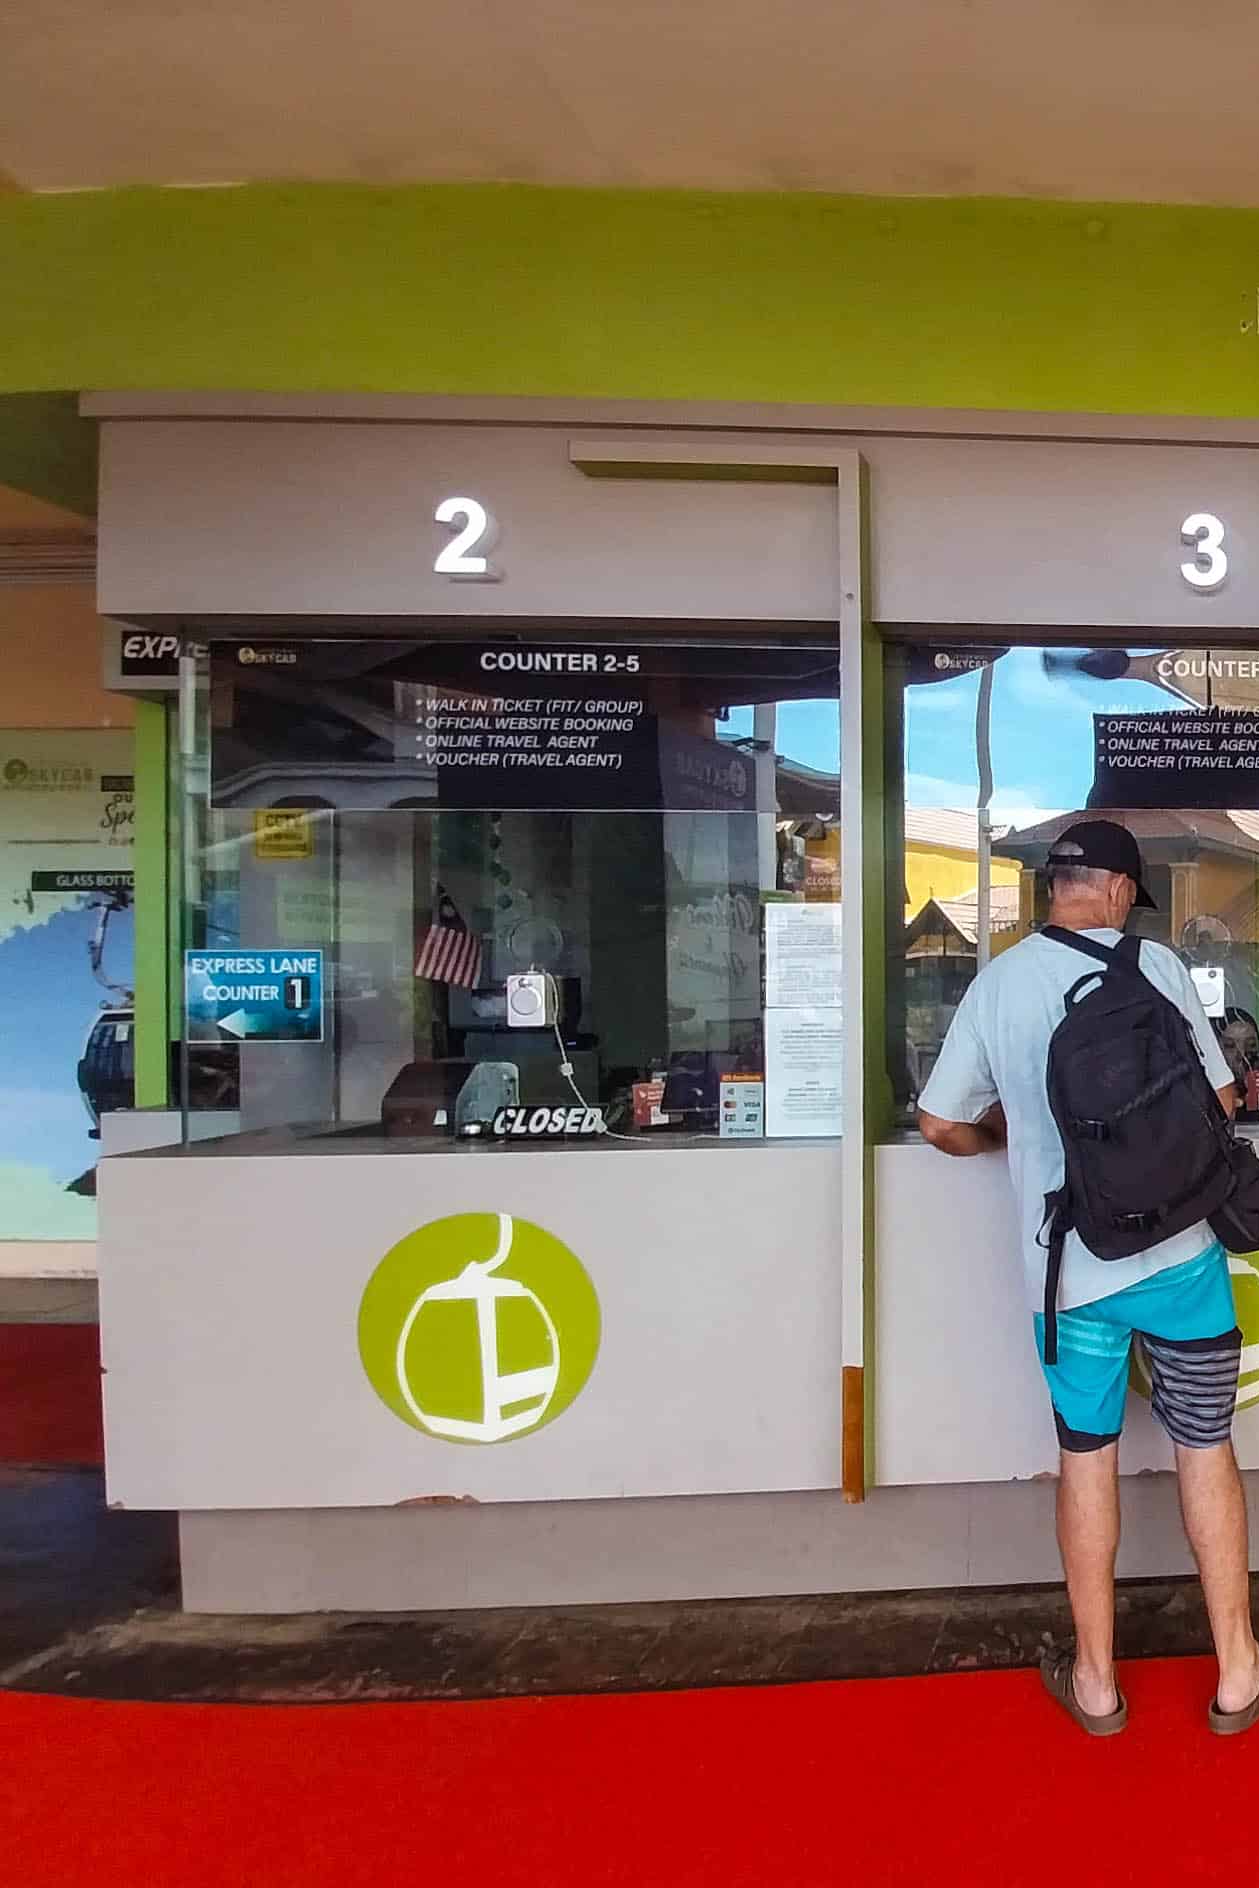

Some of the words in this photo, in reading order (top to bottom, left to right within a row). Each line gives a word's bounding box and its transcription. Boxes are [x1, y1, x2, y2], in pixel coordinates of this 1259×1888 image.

[434, 497, 487, 573] 2
[1180, 512, 1228, 587] 3
[480, 652, 598, 672] COUNTER
[603, 654, 640, 673] 2-5
[425, 698, 468, 713] WALK
[471, 699, 488, 713] IN
[491, 699, 541, 713] TICKET
[545, 700, 581, 715] (FIT/
[584, 701, 643, 716] GROUP)
[425, 716, 492, 730] OFFICIAL
[495, 717, 560, 731] WEBSITE
[563, 718, 634, 732] BOOKING
[1107, 720, 1169, 734] OFFICIAL
[1171, 721, 1231, 735] WEBSITE
[425, 734, 482, 748] ONLINE
[487, 735, 541, 748] TRAVEL
[546, 735, 600, 749] AGENT
[1107, 738, 1160, 751] ONLINE
[1163, 738, 1214, 751] TRAVEL
[426, 752, 499, 766] VOUCHER
[502, 753, 563, 769] (TRAVEL
[565, 754, 623, 770] AGENT)
[1107, 755, 1176, 768] VOUCHER
[1178, 756, 1234, 770] (TRAVEL
[55, 874, 94, 887] GLASS
[191, 957, 266, 975] EXPRESS
[270, 957, 318, 975] LANE
[202, 985, 280, 1001] COUNTER
[289, 978, 303, 1009] 1
[493, 1106, 604, 1135] CLOSED
